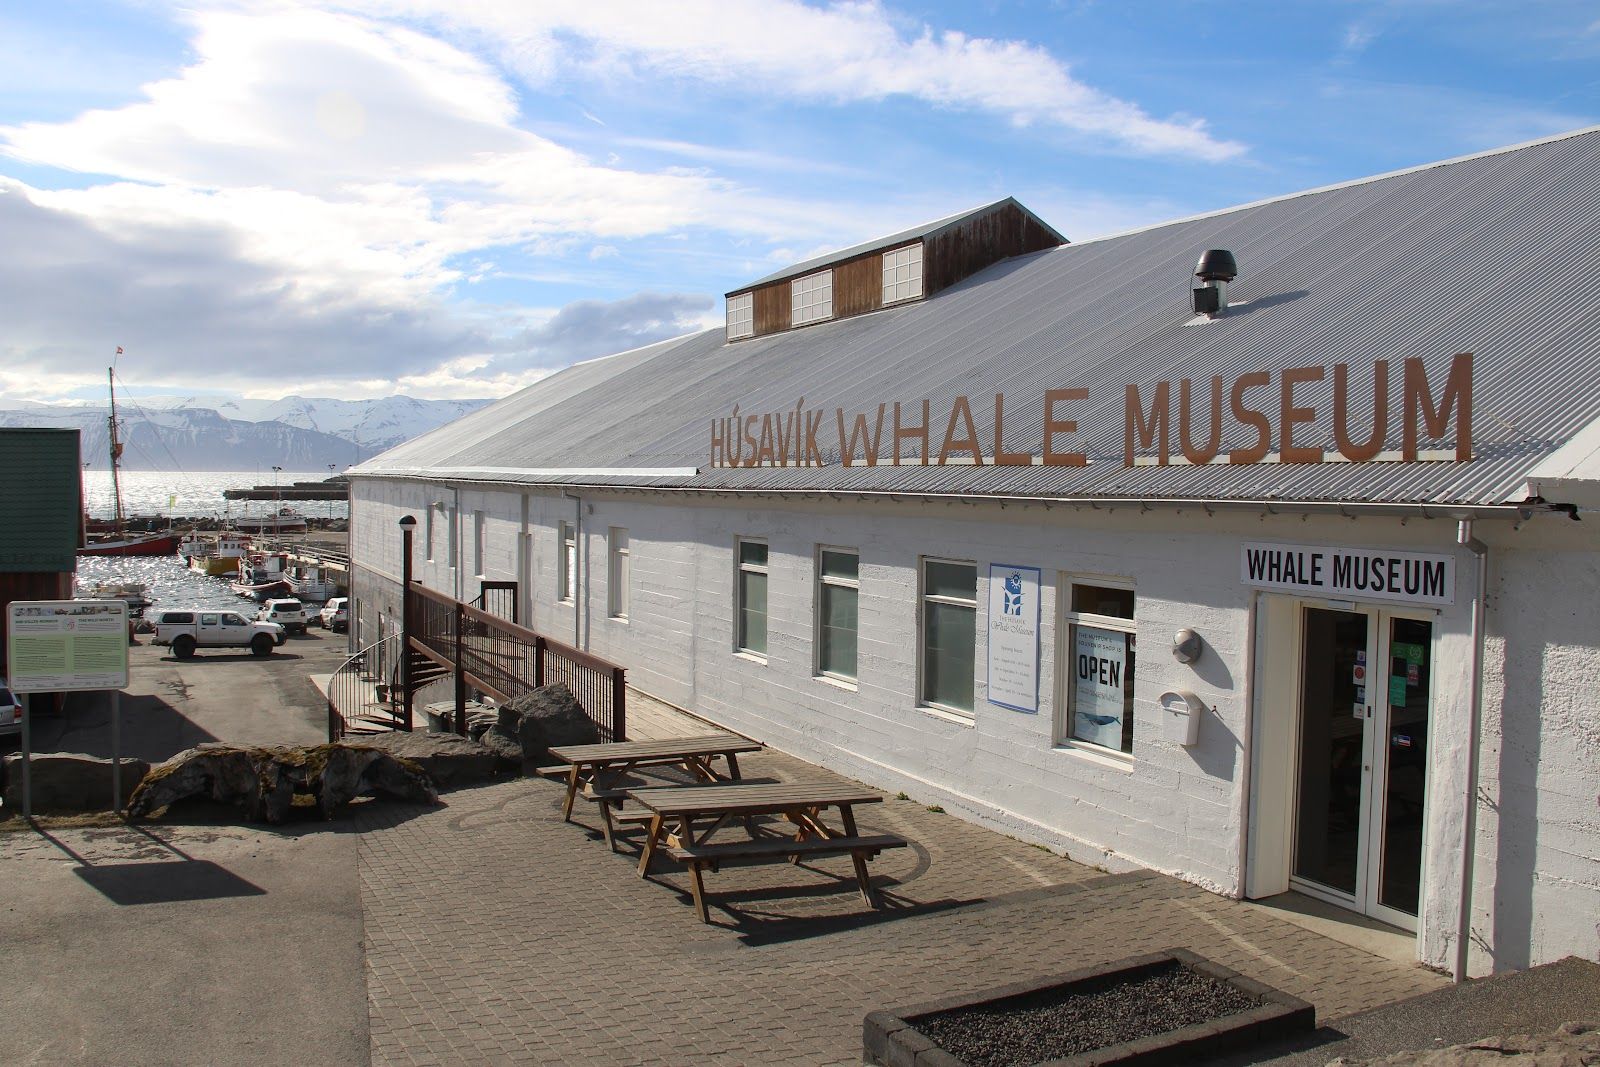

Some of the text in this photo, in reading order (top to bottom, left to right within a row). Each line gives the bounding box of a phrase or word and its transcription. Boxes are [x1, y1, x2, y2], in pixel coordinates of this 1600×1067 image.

[711, 352, 1474, 468] HÚSAVÍK WHALE MUSEUM
[1247, 549, 1445, 597] WHALE MUSEUM
[1079, 654, 1121, 688] OPEN
